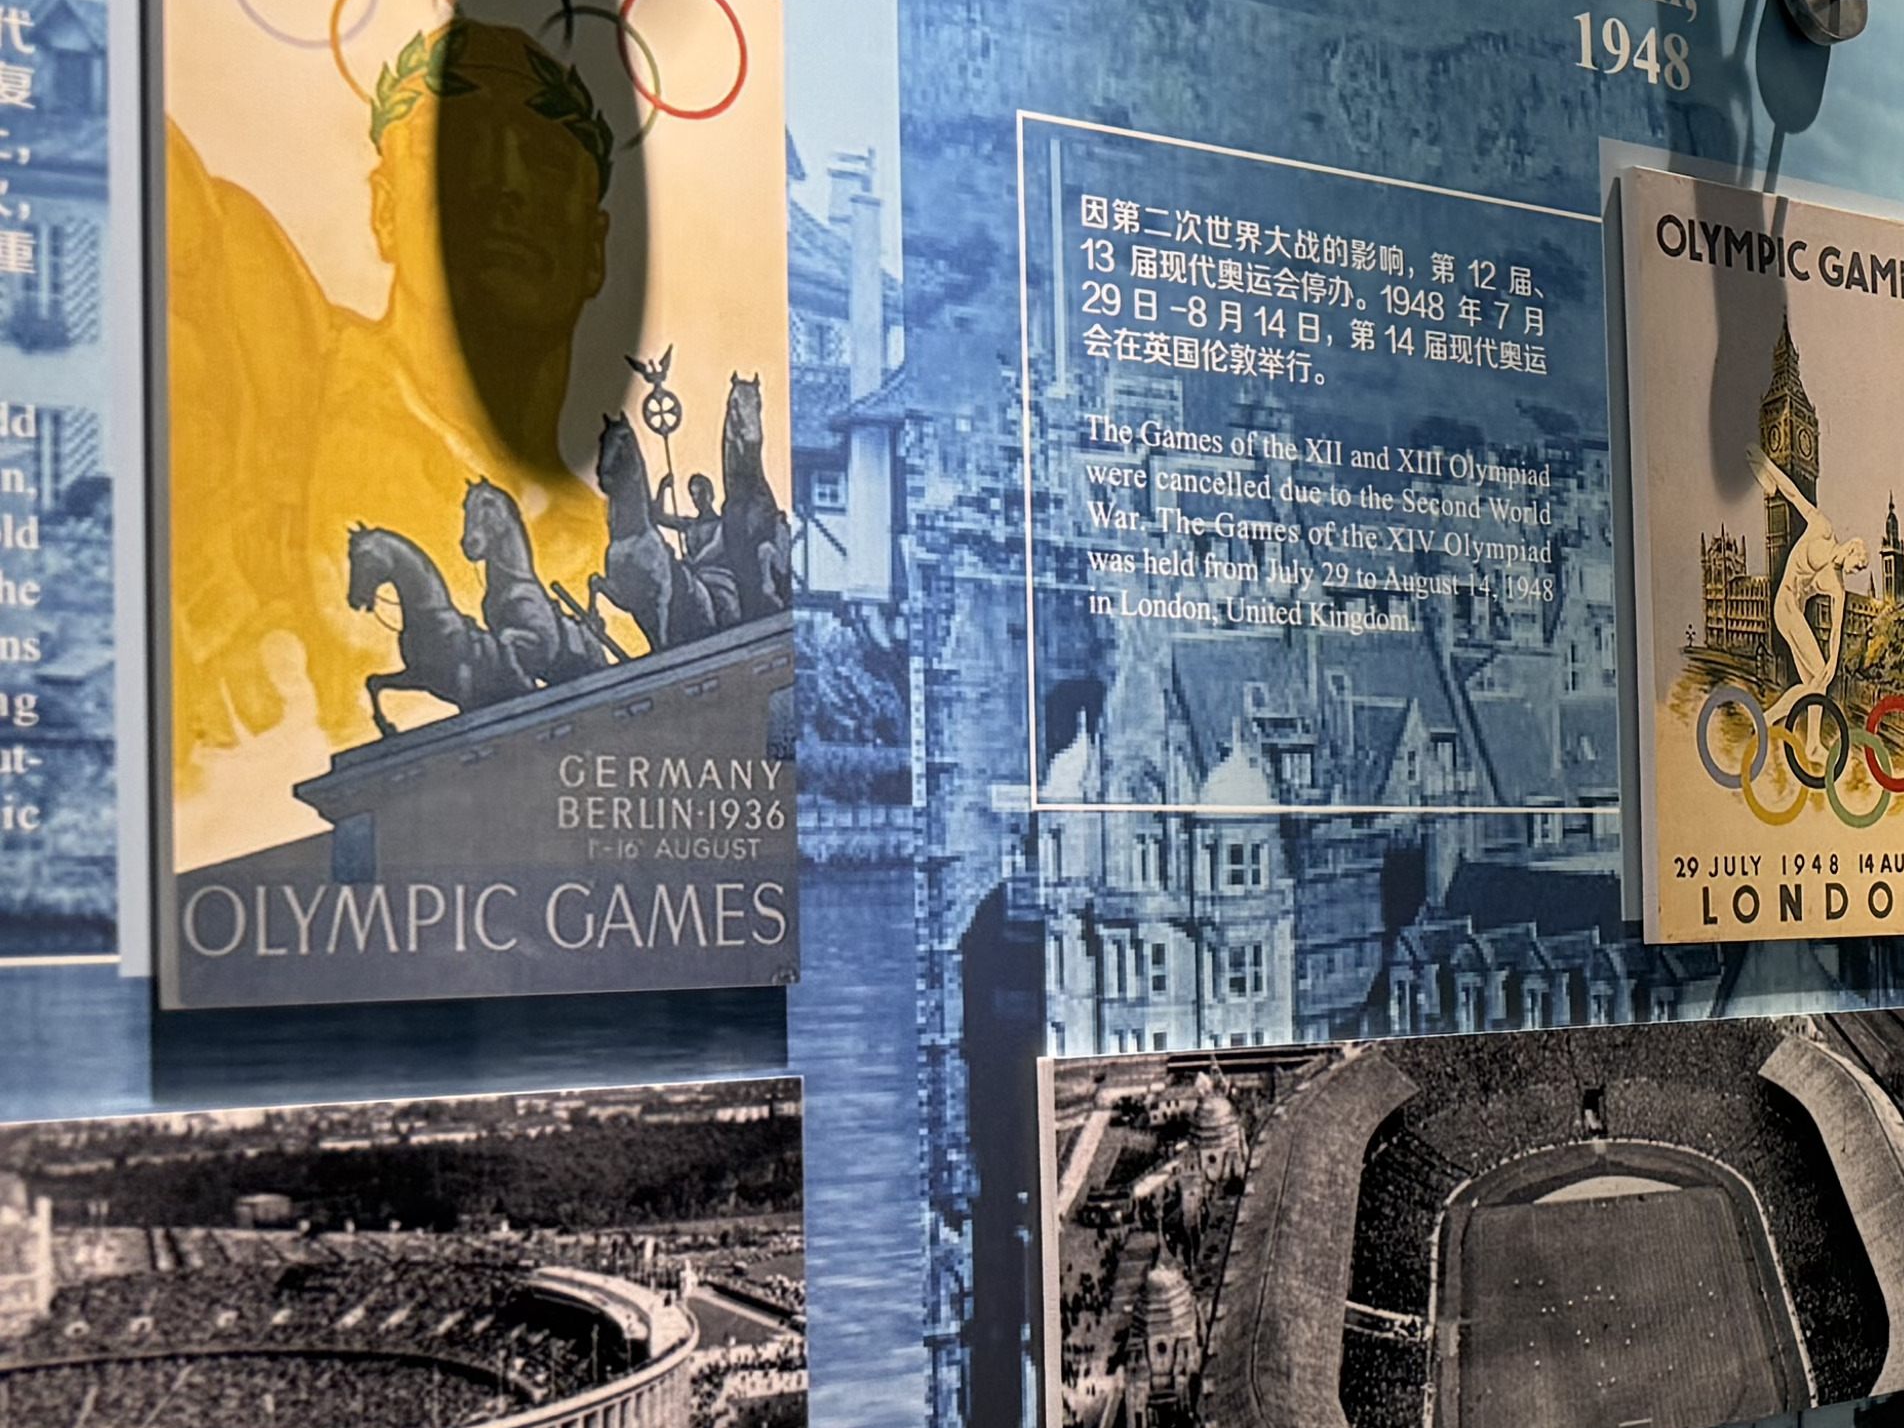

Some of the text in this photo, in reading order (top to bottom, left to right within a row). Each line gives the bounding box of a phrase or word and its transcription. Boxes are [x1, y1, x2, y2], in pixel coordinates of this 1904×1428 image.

[1573, 11, 1693, 91] 1948
[1656, 214, 1810, 281] OLYMPIC
[1083, 323, 1325, 386] 会在英国伦敦举行。
[1085, 414, 1551, 490] The Games of the XII and XIII Olympiad
[1086, 464, 1552, 526] were cancelled due to the Second World
[1086, 500, 1552, 565] War. The Games of the XIV Olympiad
[1087, 546, 1555, 602] was held from July 29 to August 14, 1948
[1089, 589, 1418, 636] in London, United Kingdom.
[559, 754, 783, 791] GERMANY
[655, 838, 762, 860] AUGUST
[1674, 856, 1700, 880] 29
[1707, 854, 1763, 880] JULY
[1781, 853, 1840, 877] 1948
[1858, 853, 1875, 875] 14
[183, 882, 787, 960] OLYMPIC GAMES
